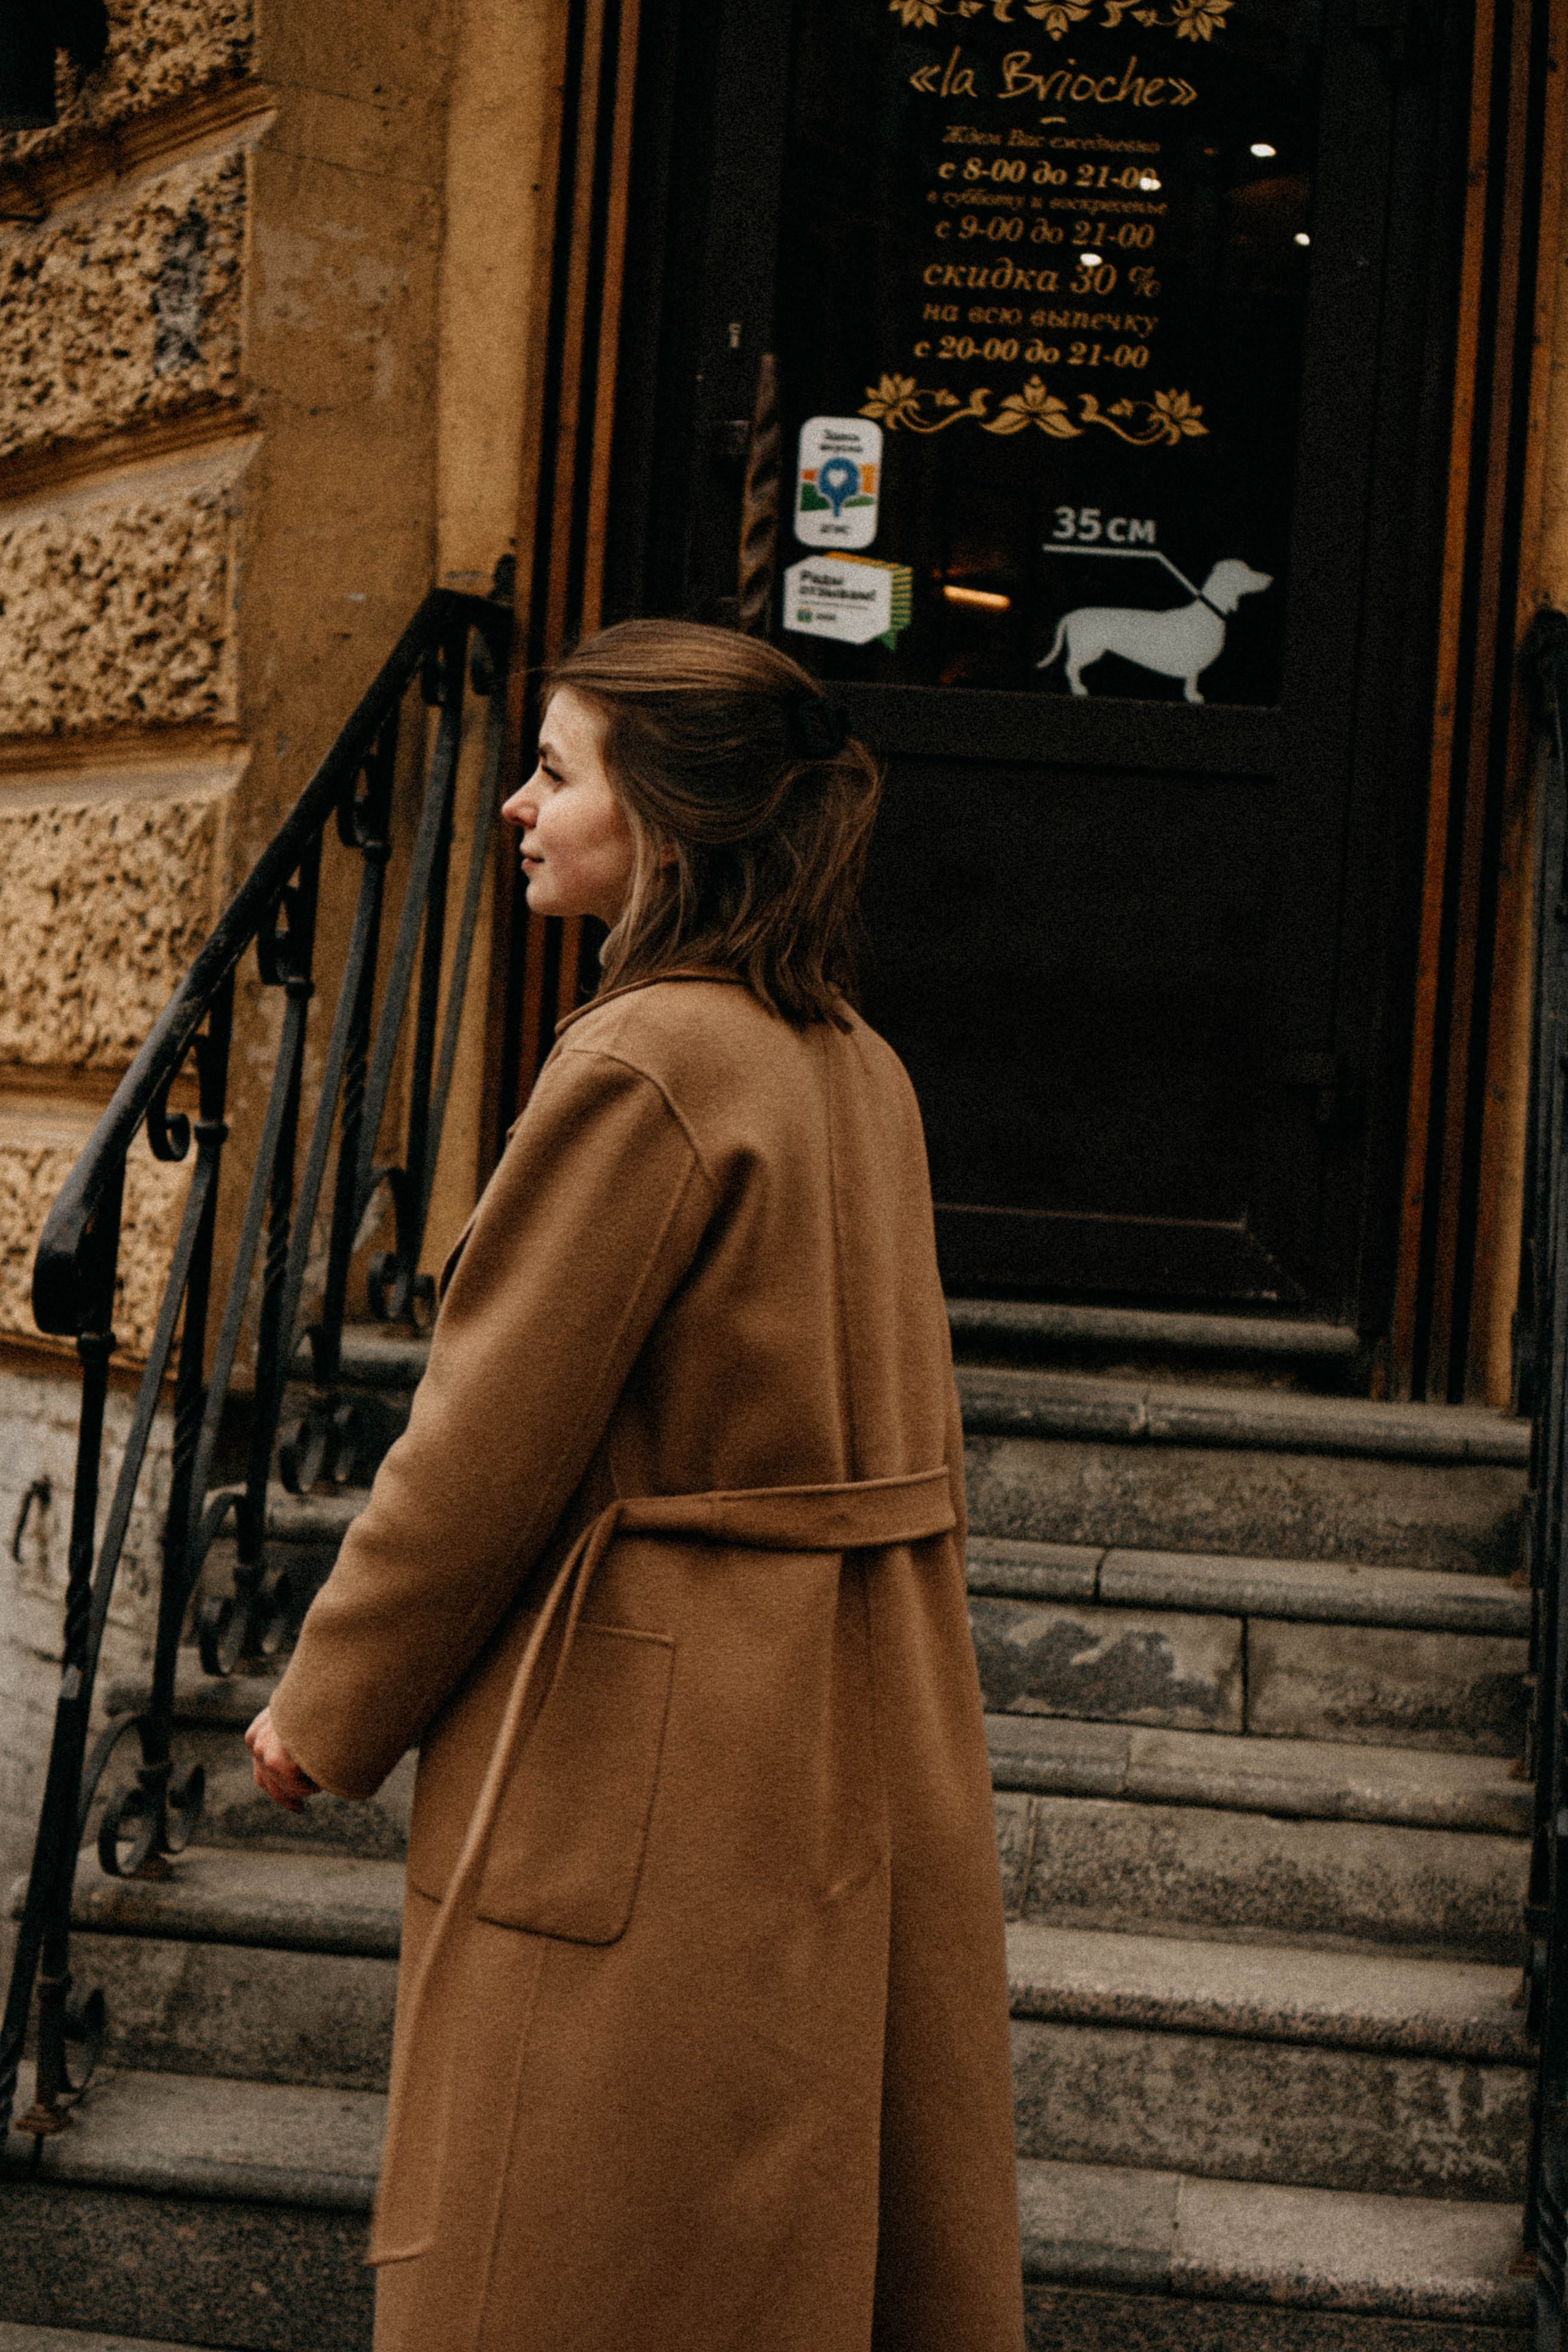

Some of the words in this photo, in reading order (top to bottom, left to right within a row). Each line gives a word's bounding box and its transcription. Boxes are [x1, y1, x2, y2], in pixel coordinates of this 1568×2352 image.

[910, 45, 978, 98] «la
[997, 51, 1198, 107] Brioche»
[963, 157, 1027, 183] 8-00
[1032, 160, 1068, 184] до
[959, 214, 1024, 242] 9-00
[1030, 217, 1064, 244] до
[1071, 220, 1155, 249] 21-00
[923, 257, 1059, 292] скидка
[1071, 262, 1118, 295] 30
[1128, 265, 1161, 296] %
[922, 304, 960, 322] на
[968, 306, 1022, 325] всю
[1030, 309, 1158, 339] выпечку
[913, 341, 931, 358] с
[937, 335, 1019, 362] 20-00
[1025, 338, 1060, 363] до
[1066, 341, 1150, 368] 21-00
[1052, 506, 1102, 541] 35
